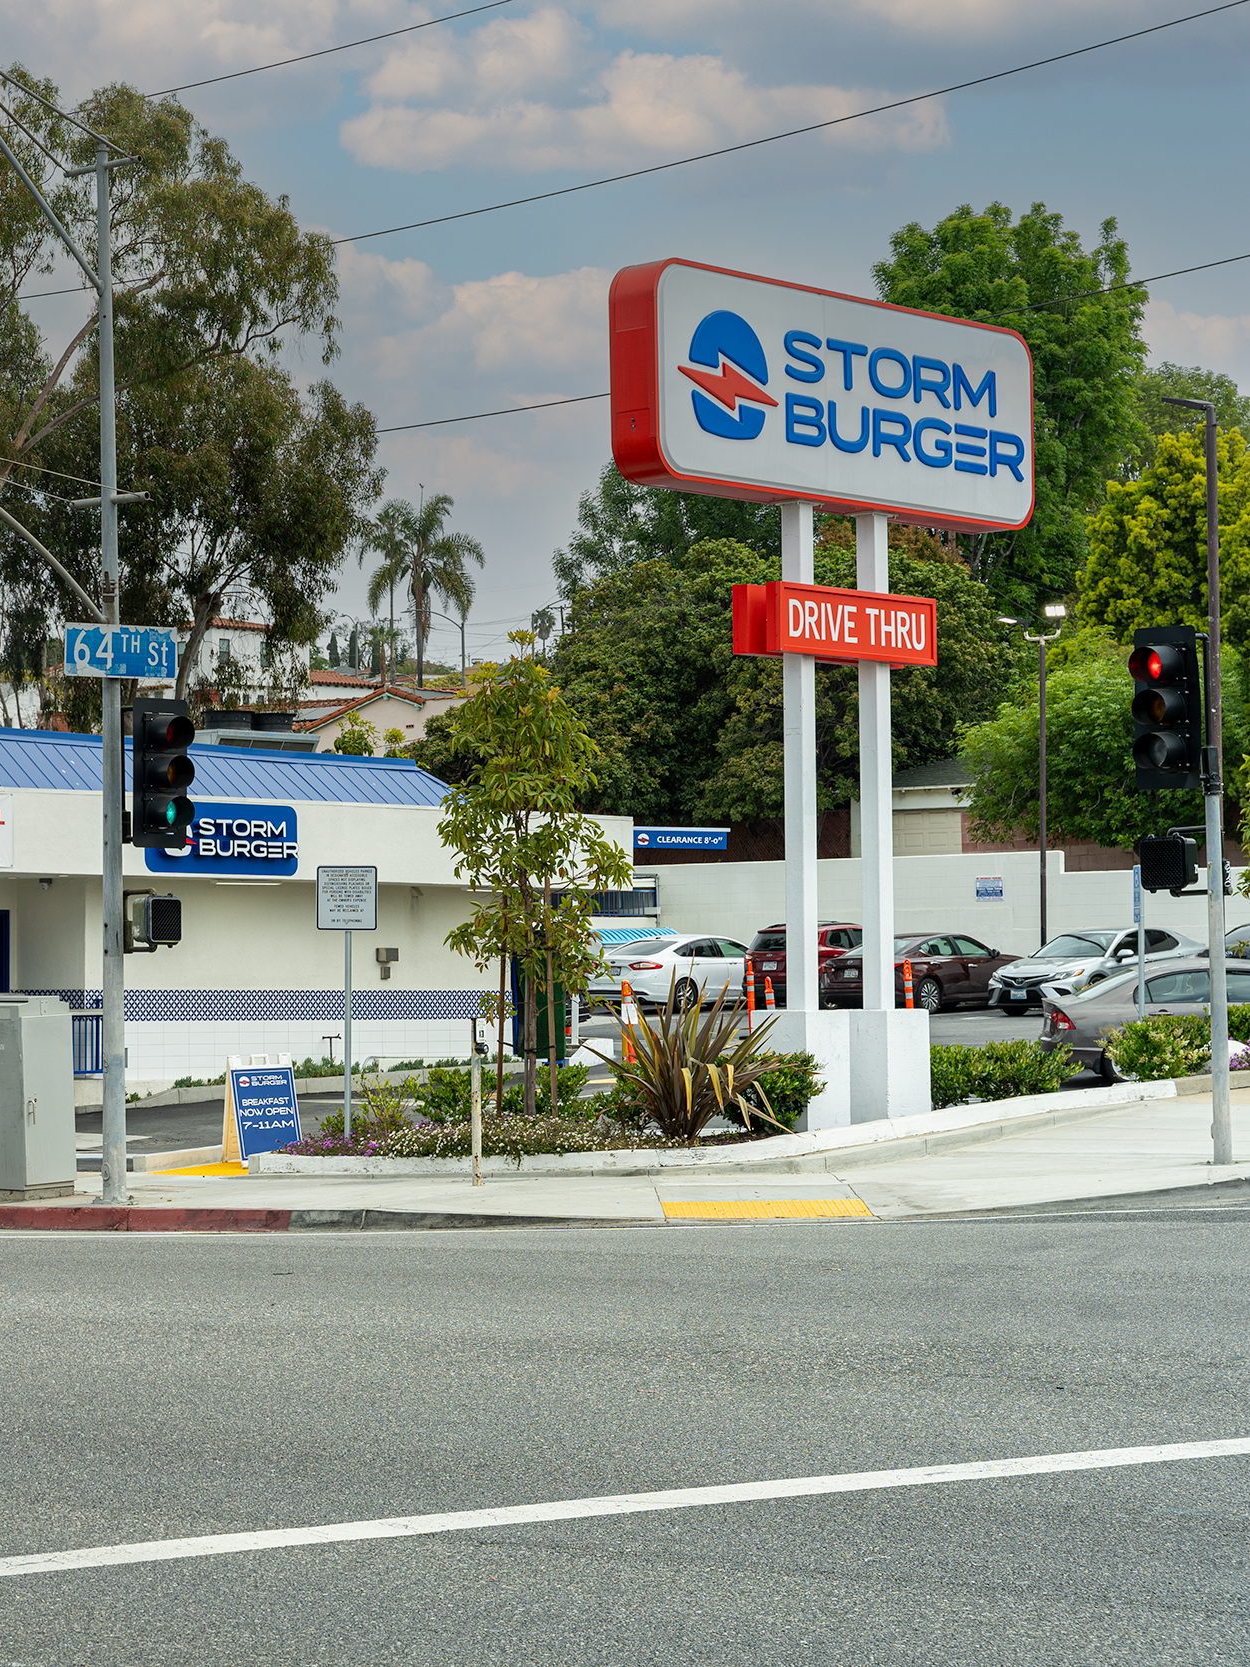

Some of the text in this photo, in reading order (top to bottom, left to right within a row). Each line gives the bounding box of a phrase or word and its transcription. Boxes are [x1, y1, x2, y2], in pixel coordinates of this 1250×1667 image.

[784, 330, 996, 418] STORM
[786, 392, 1025, 482] BURGER
[788, 599, 926, 651] DRIVE THRU
[147, 642, 168, 667] St
[199, 818, 287, 838] STORM
[199, 838, 300, 859] BURGER
[656, 836, 703, 844] CLEARANCE
[242, 1097, 289, 1106] BREAKFAST
[240, 1107, 294, 1117] NOW OPEN
[242, 1120, 294, 1130] 7-11AM
